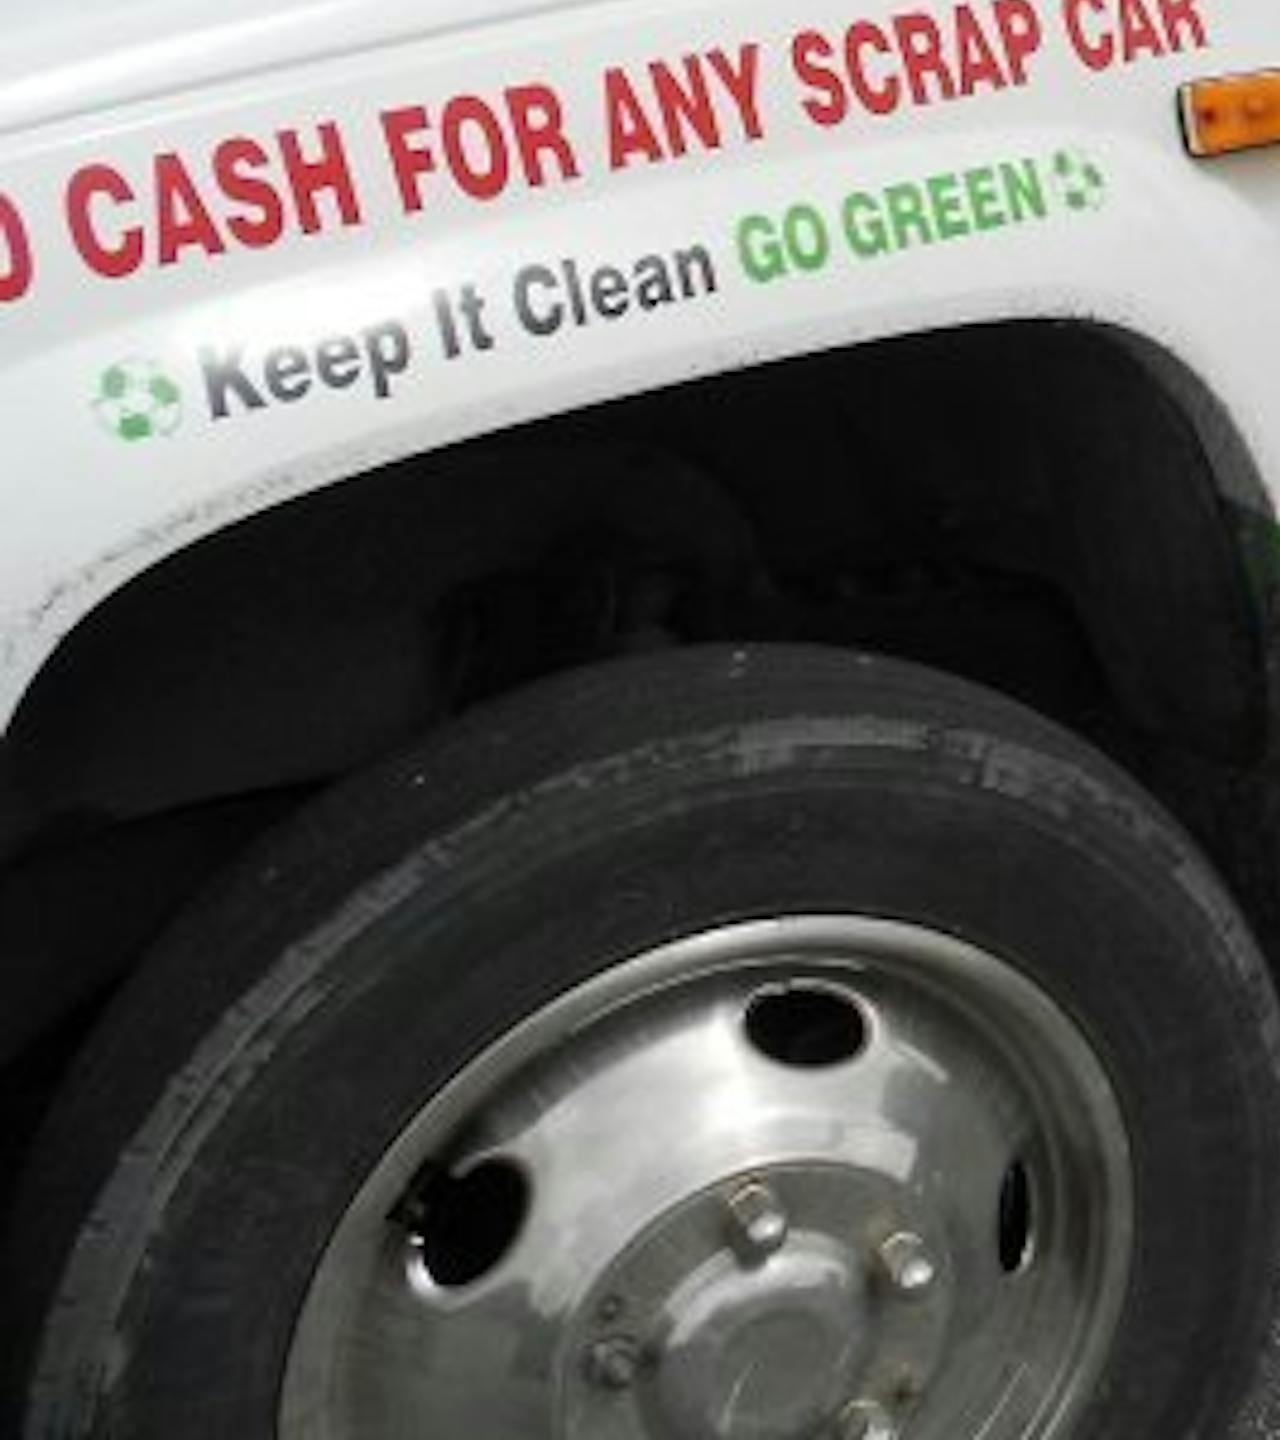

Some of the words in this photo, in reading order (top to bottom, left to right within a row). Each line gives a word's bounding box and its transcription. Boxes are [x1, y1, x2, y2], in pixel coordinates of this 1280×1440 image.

[66, 120, 360, 279] CASH
[380, 85, 578, 213] FOR
[604, 43, 763, 168] ANY
[200, 320, 412, 422] Keep
[431, 282, 495, 361] It
[513, 242, 718, 337] Clean
[735, 203, 830, 284] GO
[842, 157, 1047, 257] GREEN
